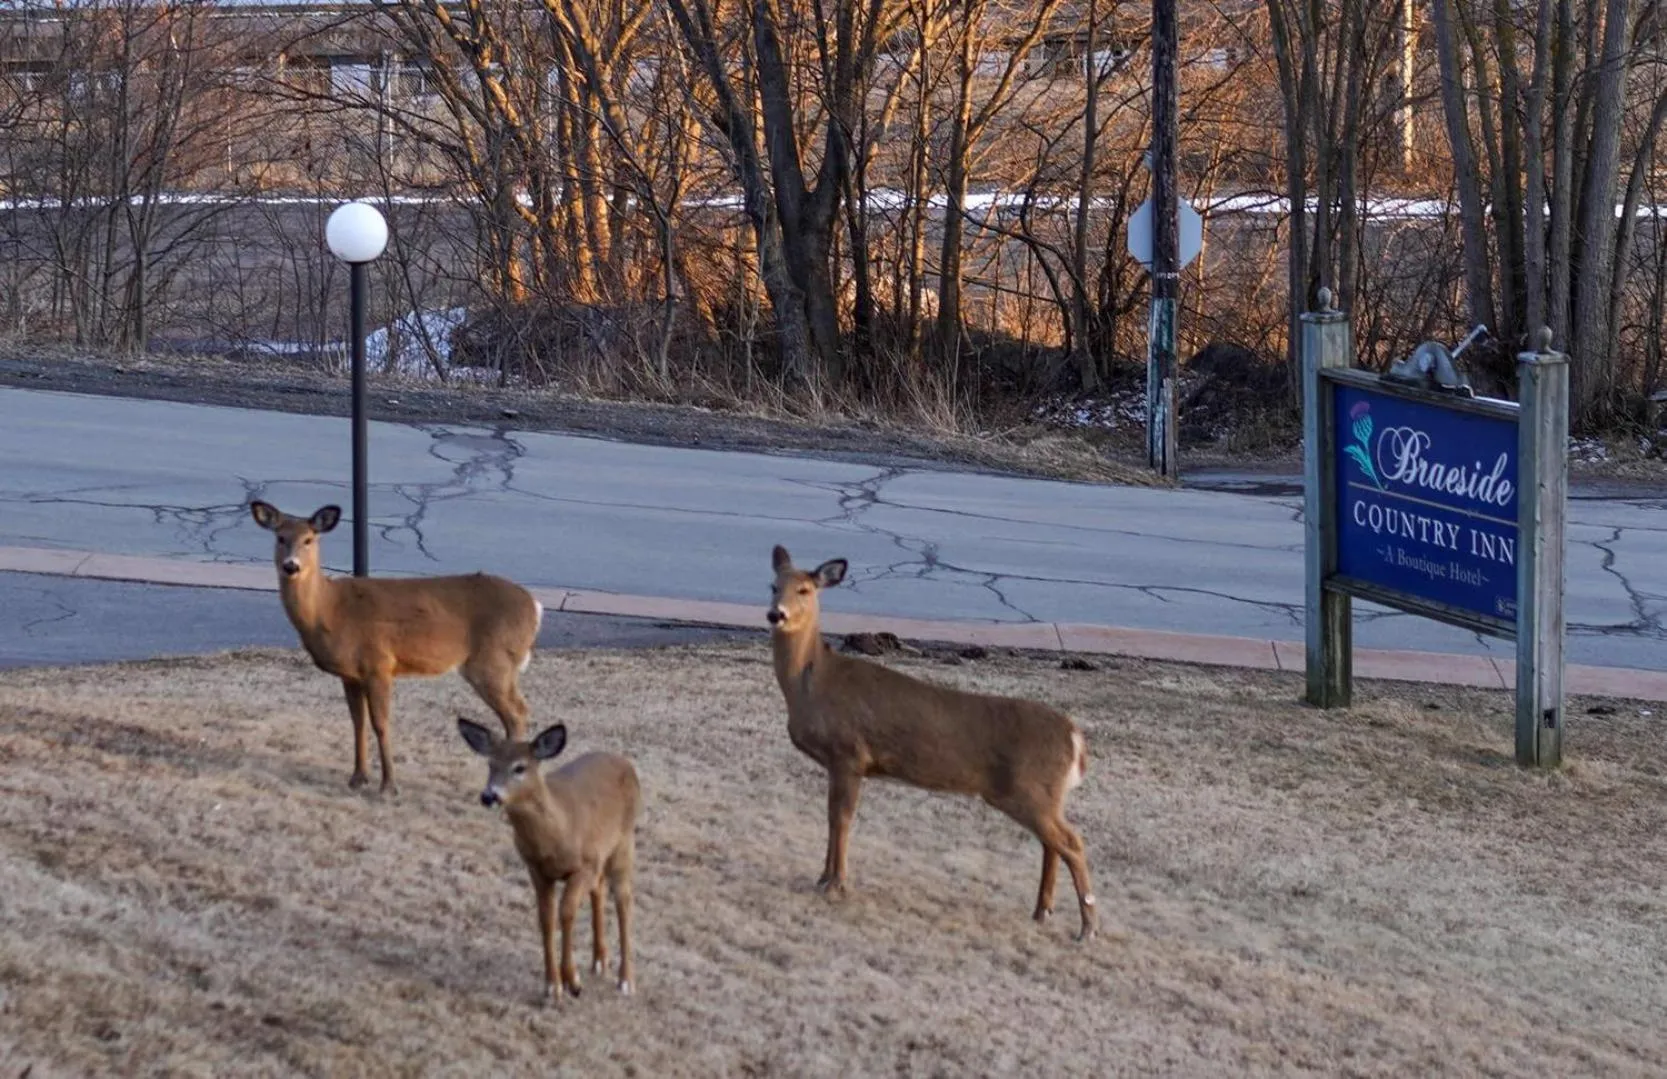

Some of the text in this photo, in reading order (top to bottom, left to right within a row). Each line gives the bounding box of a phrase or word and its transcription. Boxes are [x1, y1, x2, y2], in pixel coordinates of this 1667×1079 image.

[1377, 427, 1515, 506] Braeside
[1353, 500, 1515, 565] COUNTRY INN
[1398, 548, 1446, 580] Boutique
